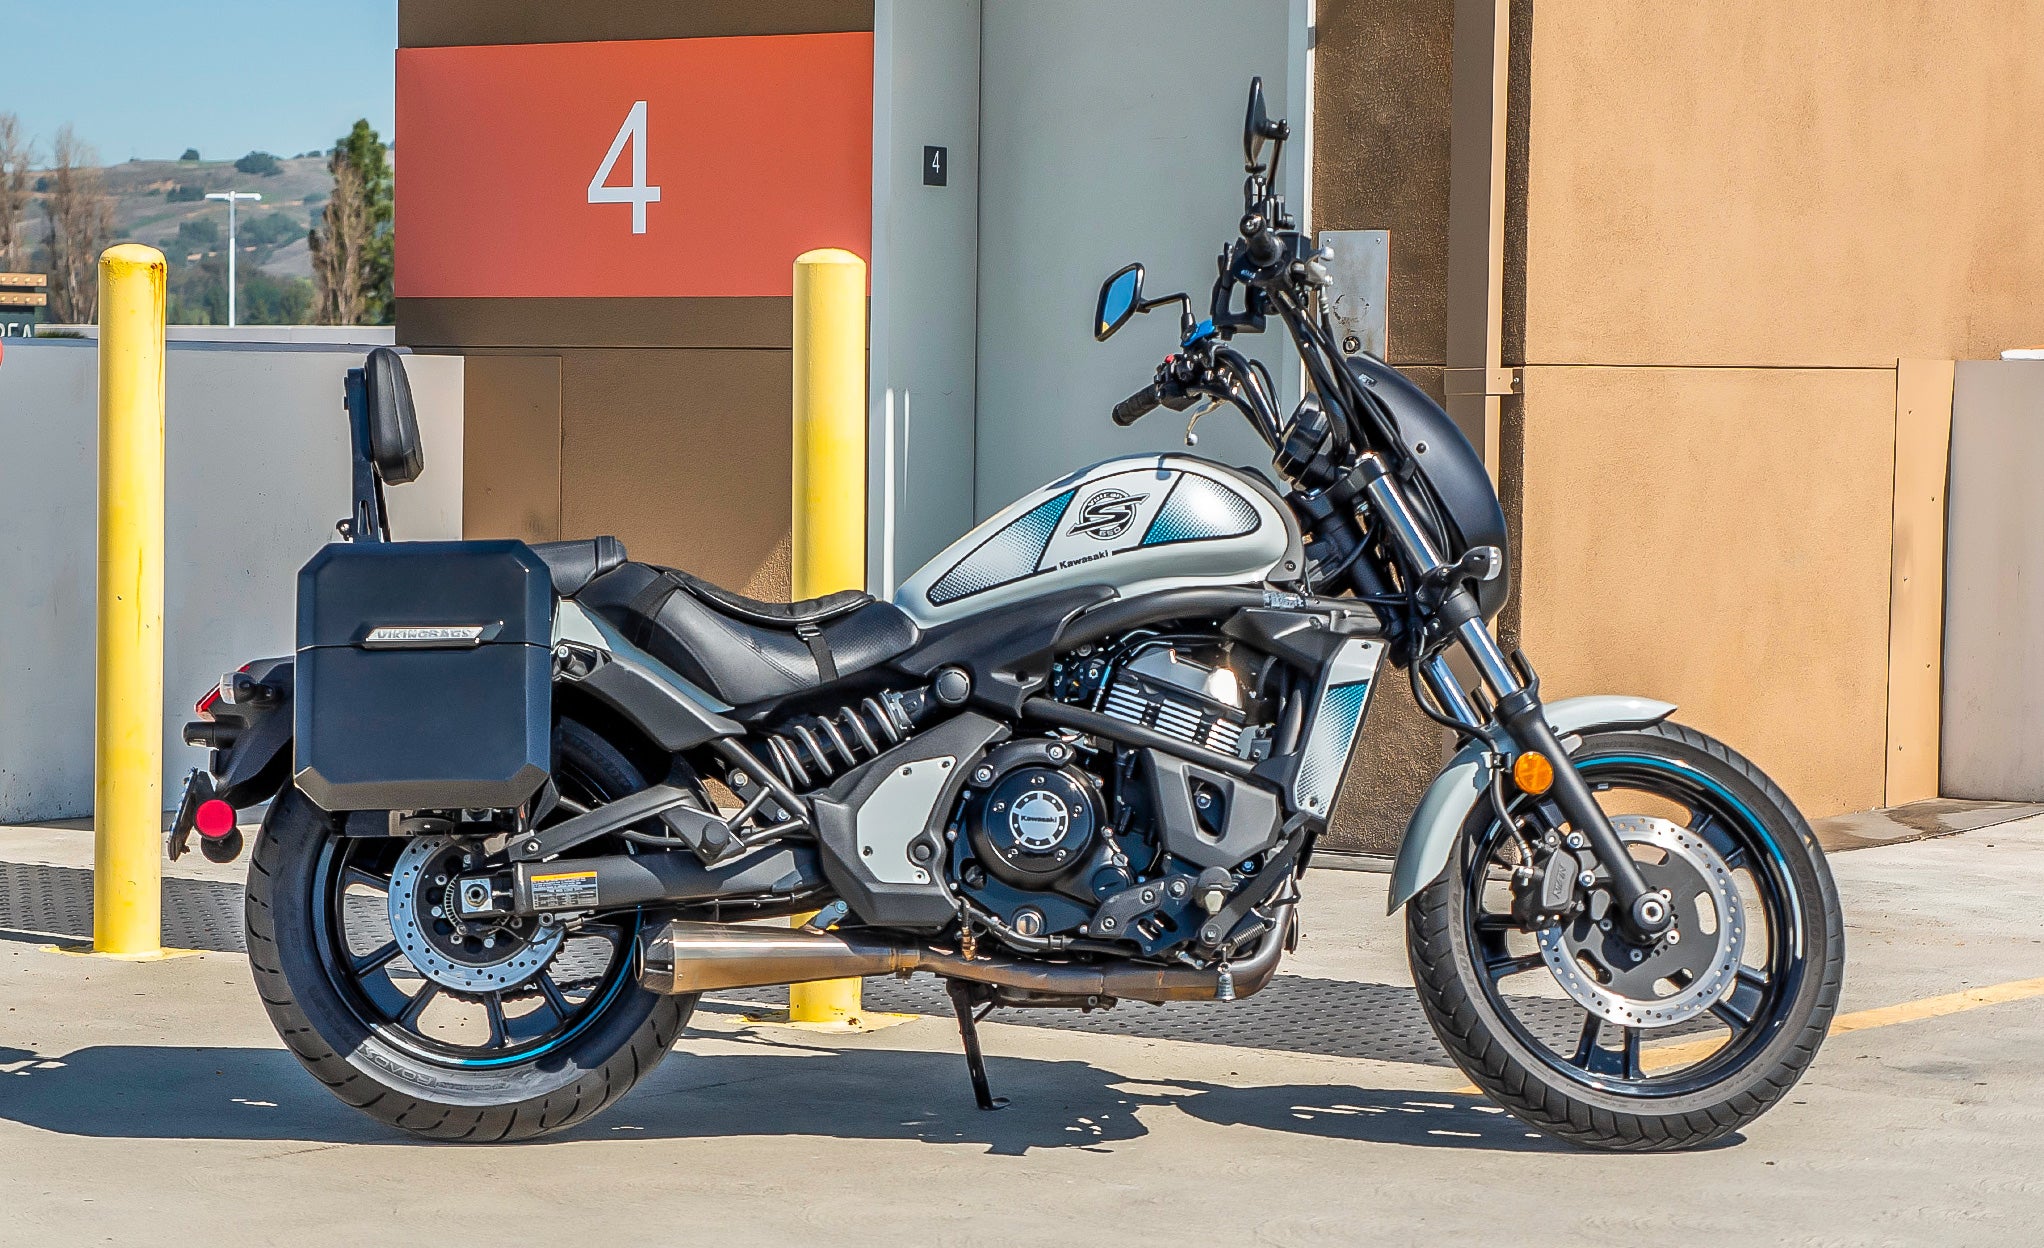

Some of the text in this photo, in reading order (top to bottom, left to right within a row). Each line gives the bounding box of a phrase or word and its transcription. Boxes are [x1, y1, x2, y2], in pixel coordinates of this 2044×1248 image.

[588, 101, 661, 214] 4
[932, 150, 940, 173] 4
[1059, 550, 1108, 569] Kawasaki
[1021, 815, 1057, 823] Kawasaki
